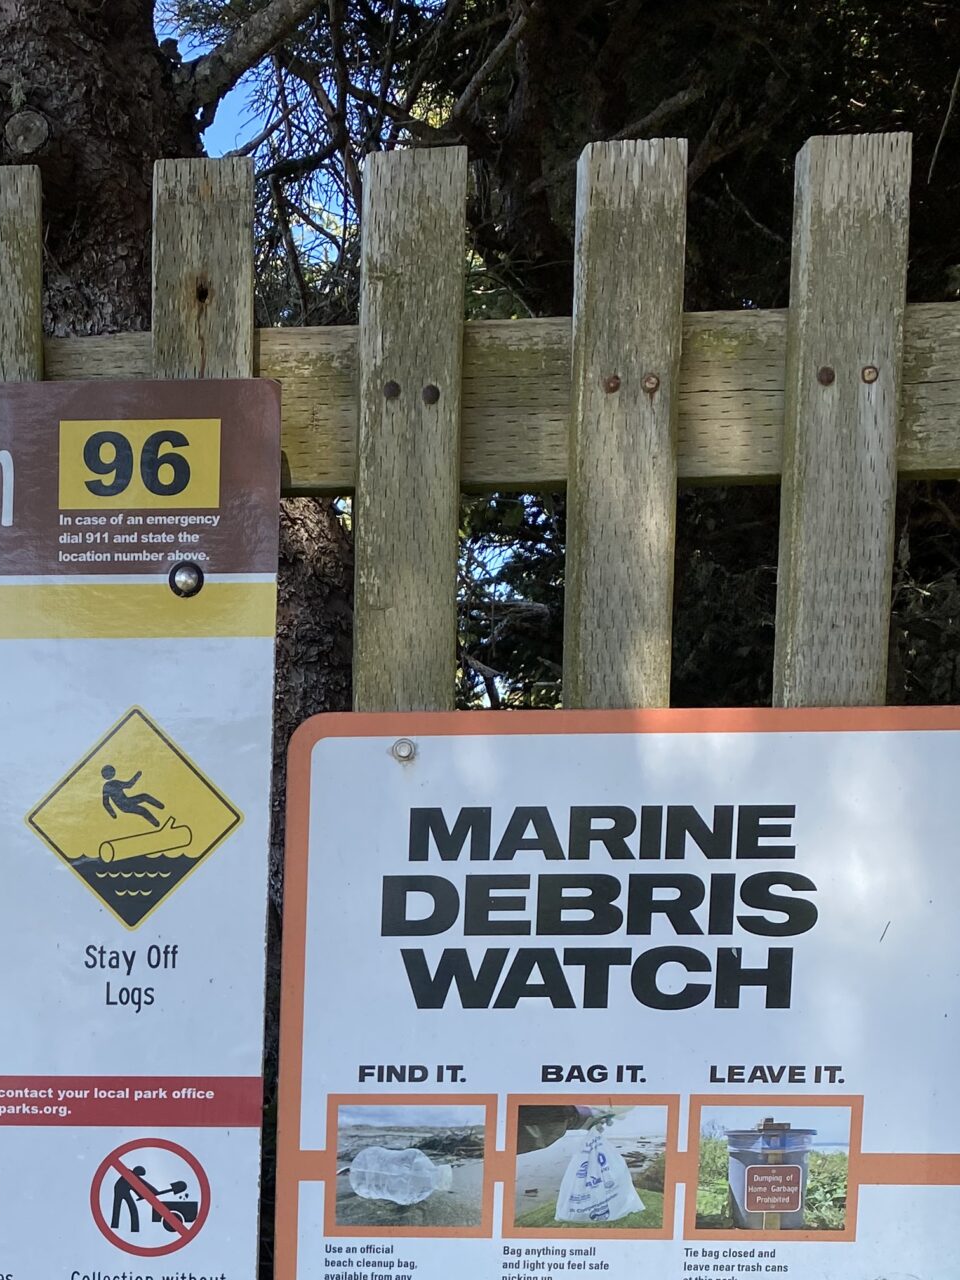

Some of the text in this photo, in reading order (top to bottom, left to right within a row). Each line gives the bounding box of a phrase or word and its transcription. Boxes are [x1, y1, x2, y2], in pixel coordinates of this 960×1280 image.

[83, 431, 191, 497] 96
[59, 513, 220, 527] In case of an emergency
[58, 531, 199, 543] dial 911 and state the
[408, 804, 796, 862] MARINE
[380, 871, 819, 937] DEBRIS
[84, 944, 178, 976] Stay Off
[399, 945, 794, 1011] WATCH
[105, 981, 154, 1013] Logs
[358, 1064, 466, 1082] FIND IT.
[541, 1064, 646, 1083] BAG IT.
[709, 1065, 844, 1083] LEAVE IT.
[57, 1089, 90, 1100] your
[94, 1087, 129, 1098] local
[134, 1087, 167, 1101] park
[171, 1087, 214, 1098] office
[771, 1185, 798, 1194] Garbage
[756, 1196, 790, 1204] Prohibited
